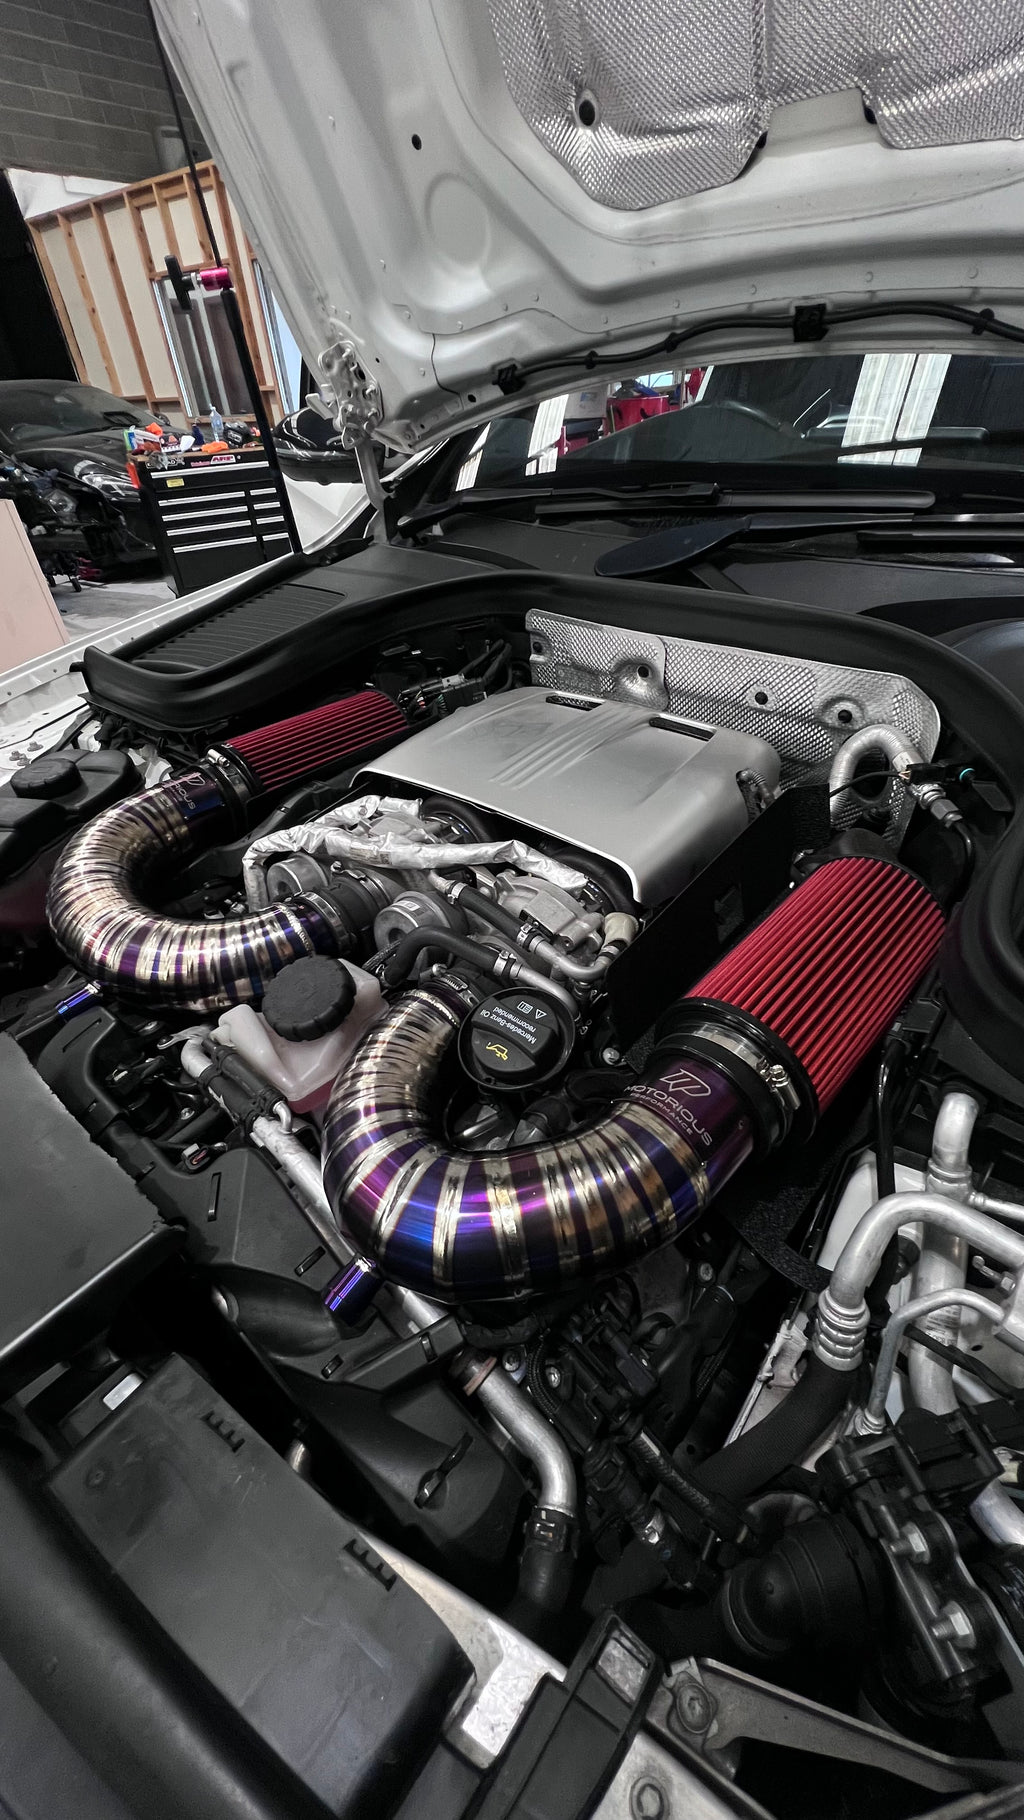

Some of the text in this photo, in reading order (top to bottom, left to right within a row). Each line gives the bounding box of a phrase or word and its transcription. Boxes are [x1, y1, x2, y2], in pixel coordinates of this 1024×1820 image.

[480, 1009, 537, 1045] Mercedes-Benz Oil
[493, 1006, 536, 1033] recommended
[623, 1085, 713, 1146] MOTORIOUS
[630, 1092, 693, 1136] PERFORMANCE
